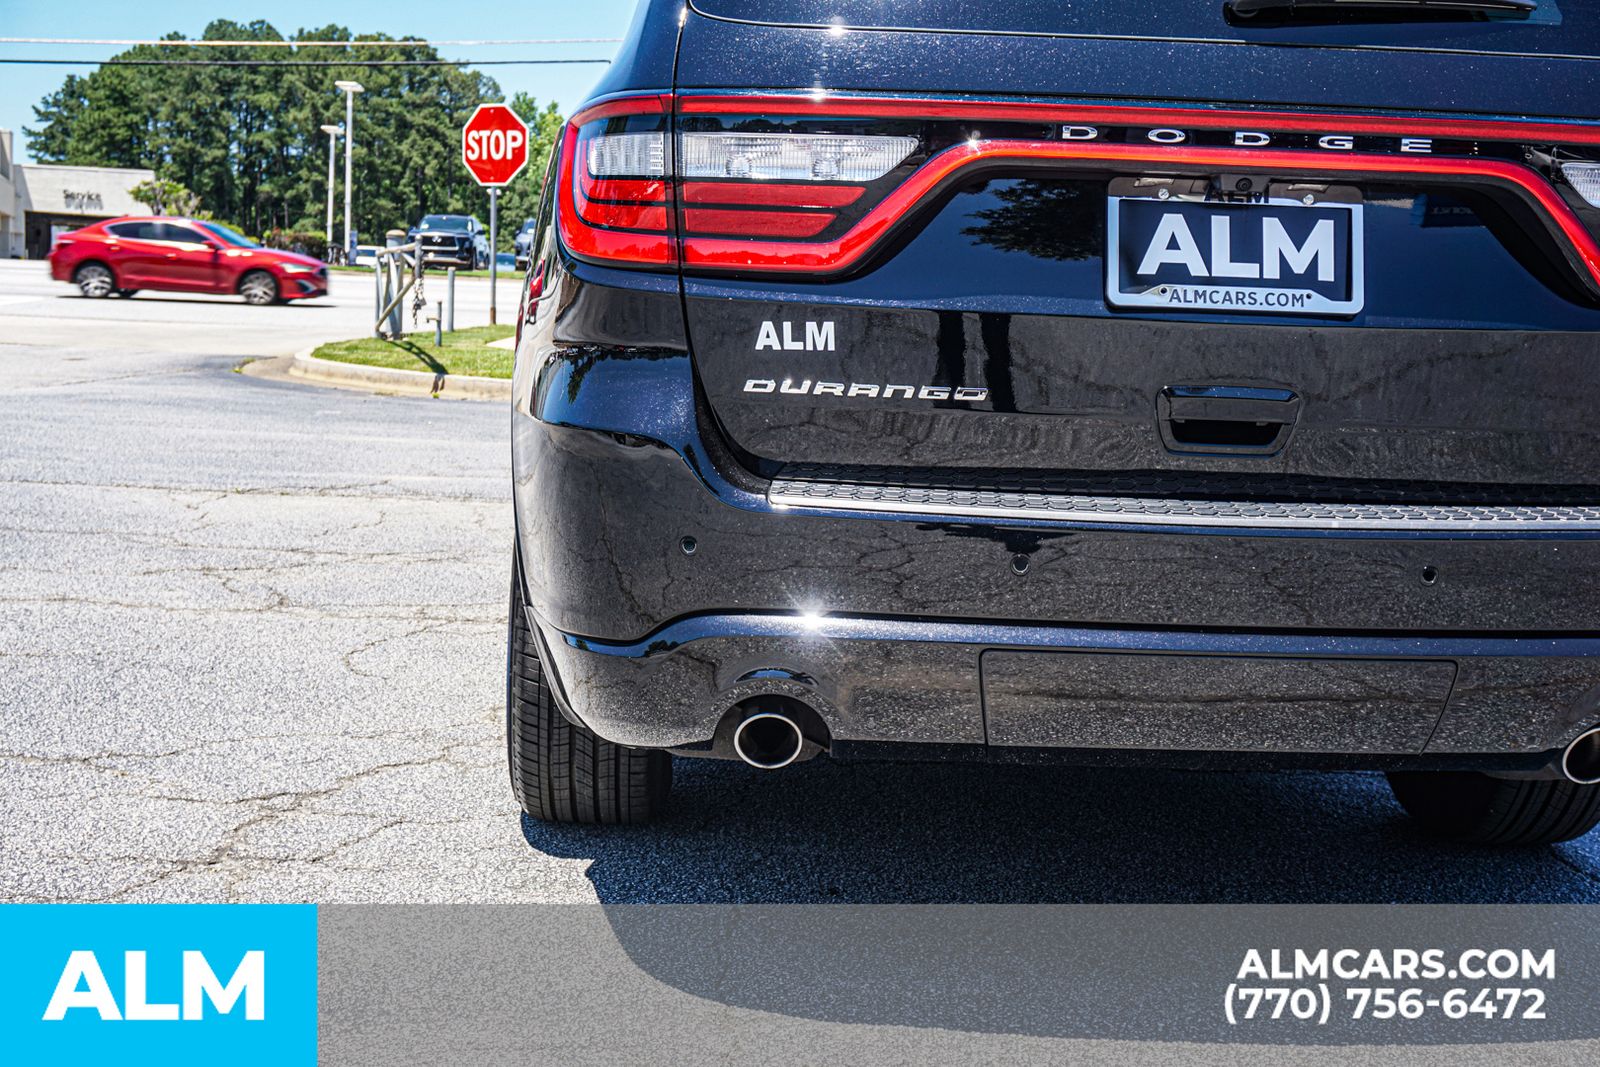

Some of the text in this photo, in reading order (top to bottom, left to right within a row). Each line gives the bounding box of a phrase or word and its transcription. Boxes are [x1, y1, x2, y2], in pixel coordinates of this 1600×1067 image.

[466, 129, 524, 161] STOP
[1062, 124, 1433, 153] DODGE
[1136, 213, 1335, 282] ALM
[1169, 288, 1305, 308] ALMCARS.COM
[755, 321, 836, 351] ALM
[743, 379, 989, 402] DURANGO
